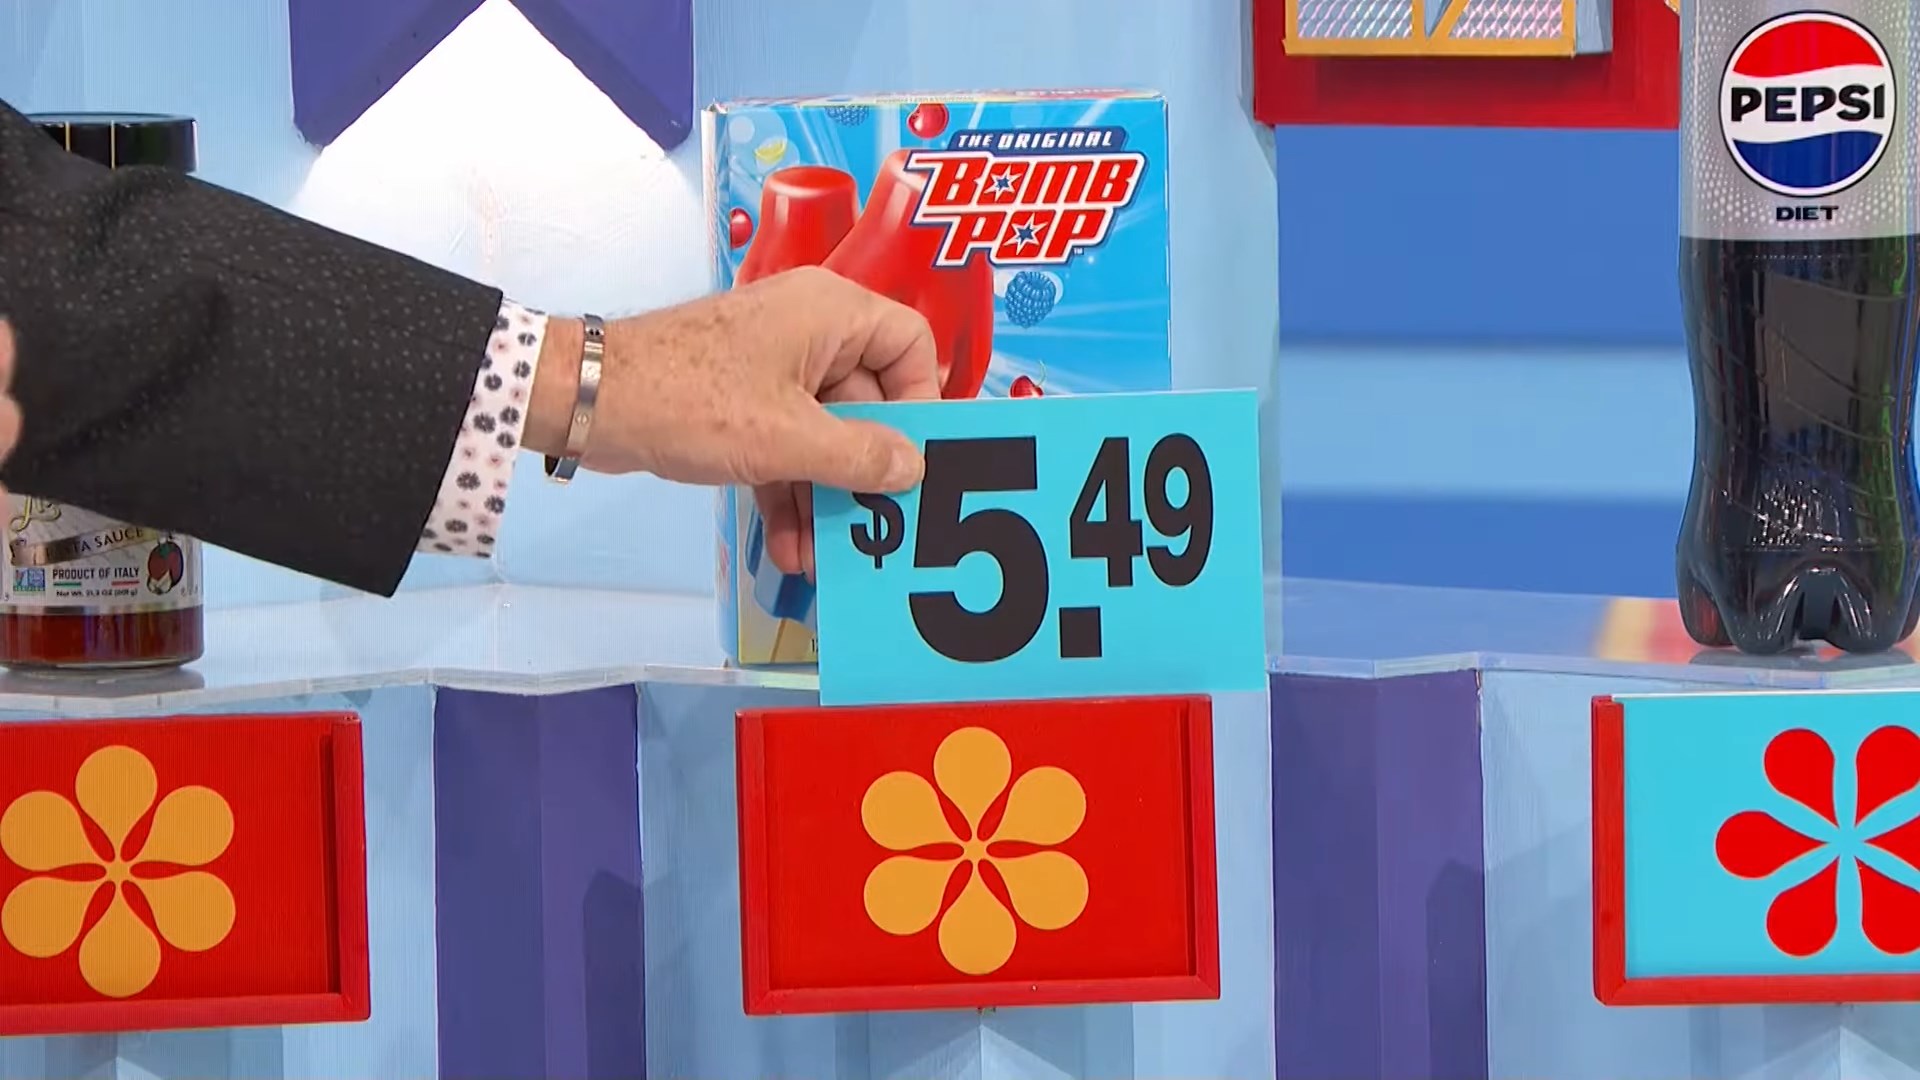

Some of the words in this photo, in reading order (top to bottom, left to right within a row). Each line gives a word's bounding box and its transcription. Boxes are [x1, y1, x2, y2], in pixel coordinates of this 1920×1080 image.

[1731, 84, 1885, 121] PEPSI
[958, 133, 993, 148] THE
[997, 131, 1113, 149] ORIGINAL
[913, 156, 1139, 207] BOMB
[1776, 206, 1839, 221] DIET
[921, 208, 1107, 261] POP
[94, 527, 144, 548] SAUCE
[52, 567, 95, 580] PRODUCT
[98, 567, 111, 580] OF
[114, 566, 140, 579] ITALY
